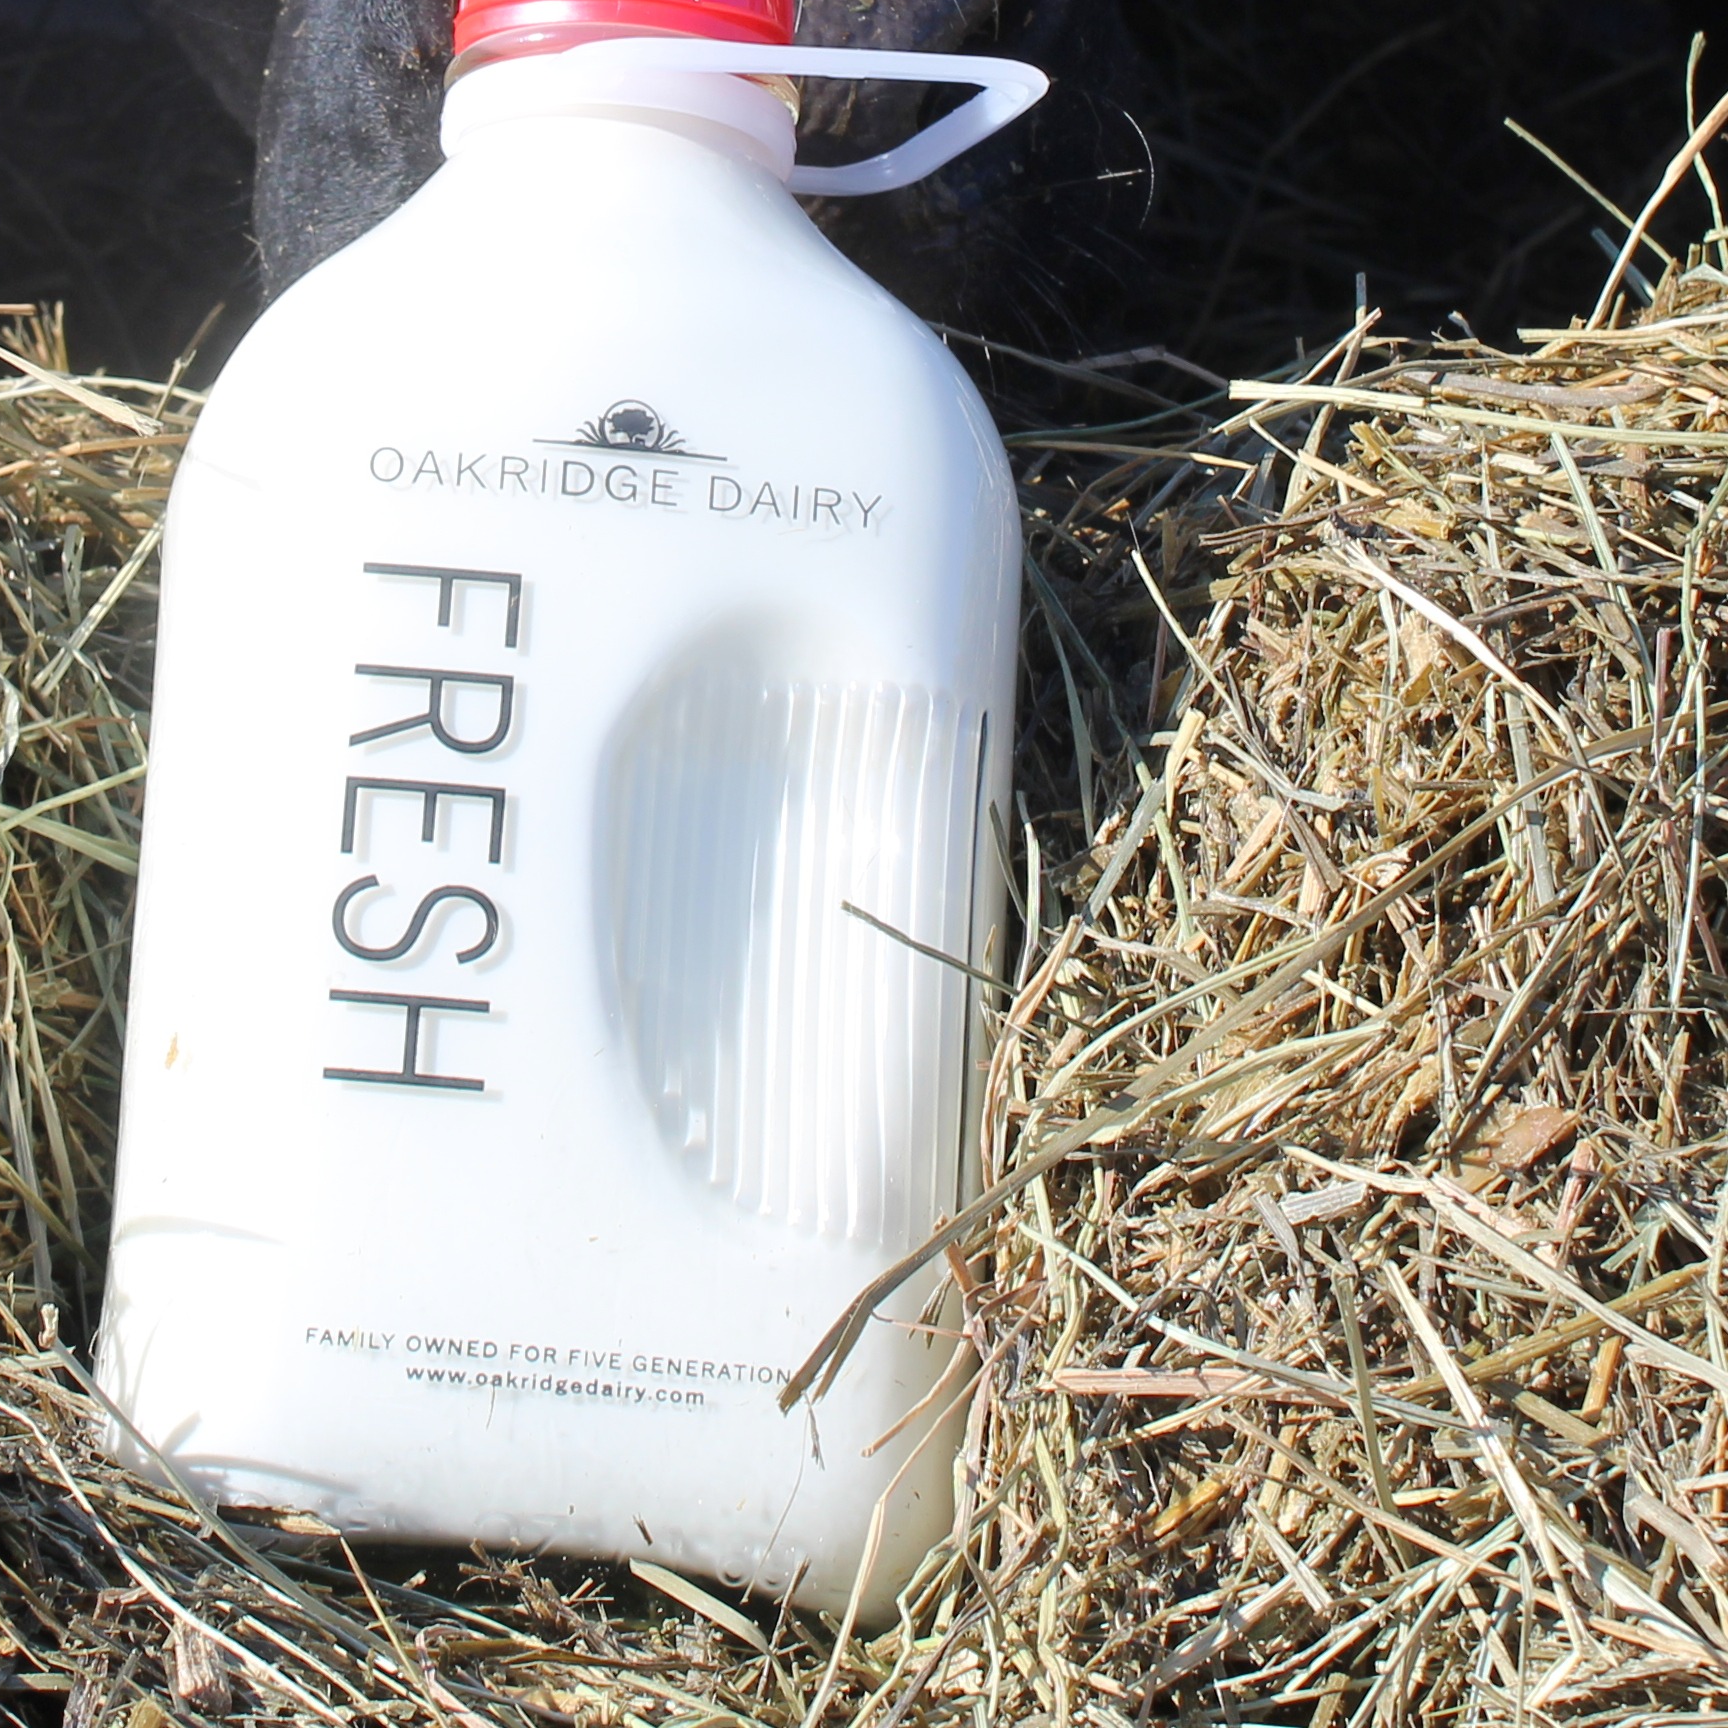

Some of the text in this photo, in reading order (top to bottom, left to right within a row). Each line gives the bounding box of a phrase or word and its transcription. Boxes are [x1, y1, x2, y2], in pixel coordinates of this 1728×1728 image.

[370, 446, 883, 529] OAKRIDGE DAIRY
[322, 562, 523, 1092] FRESH
[305, 1327, 792, 1385] FAMILY OWNED FOR FIVE GENERATION
[405, 1366, 705, 1406] www.oakridgedairy.com
